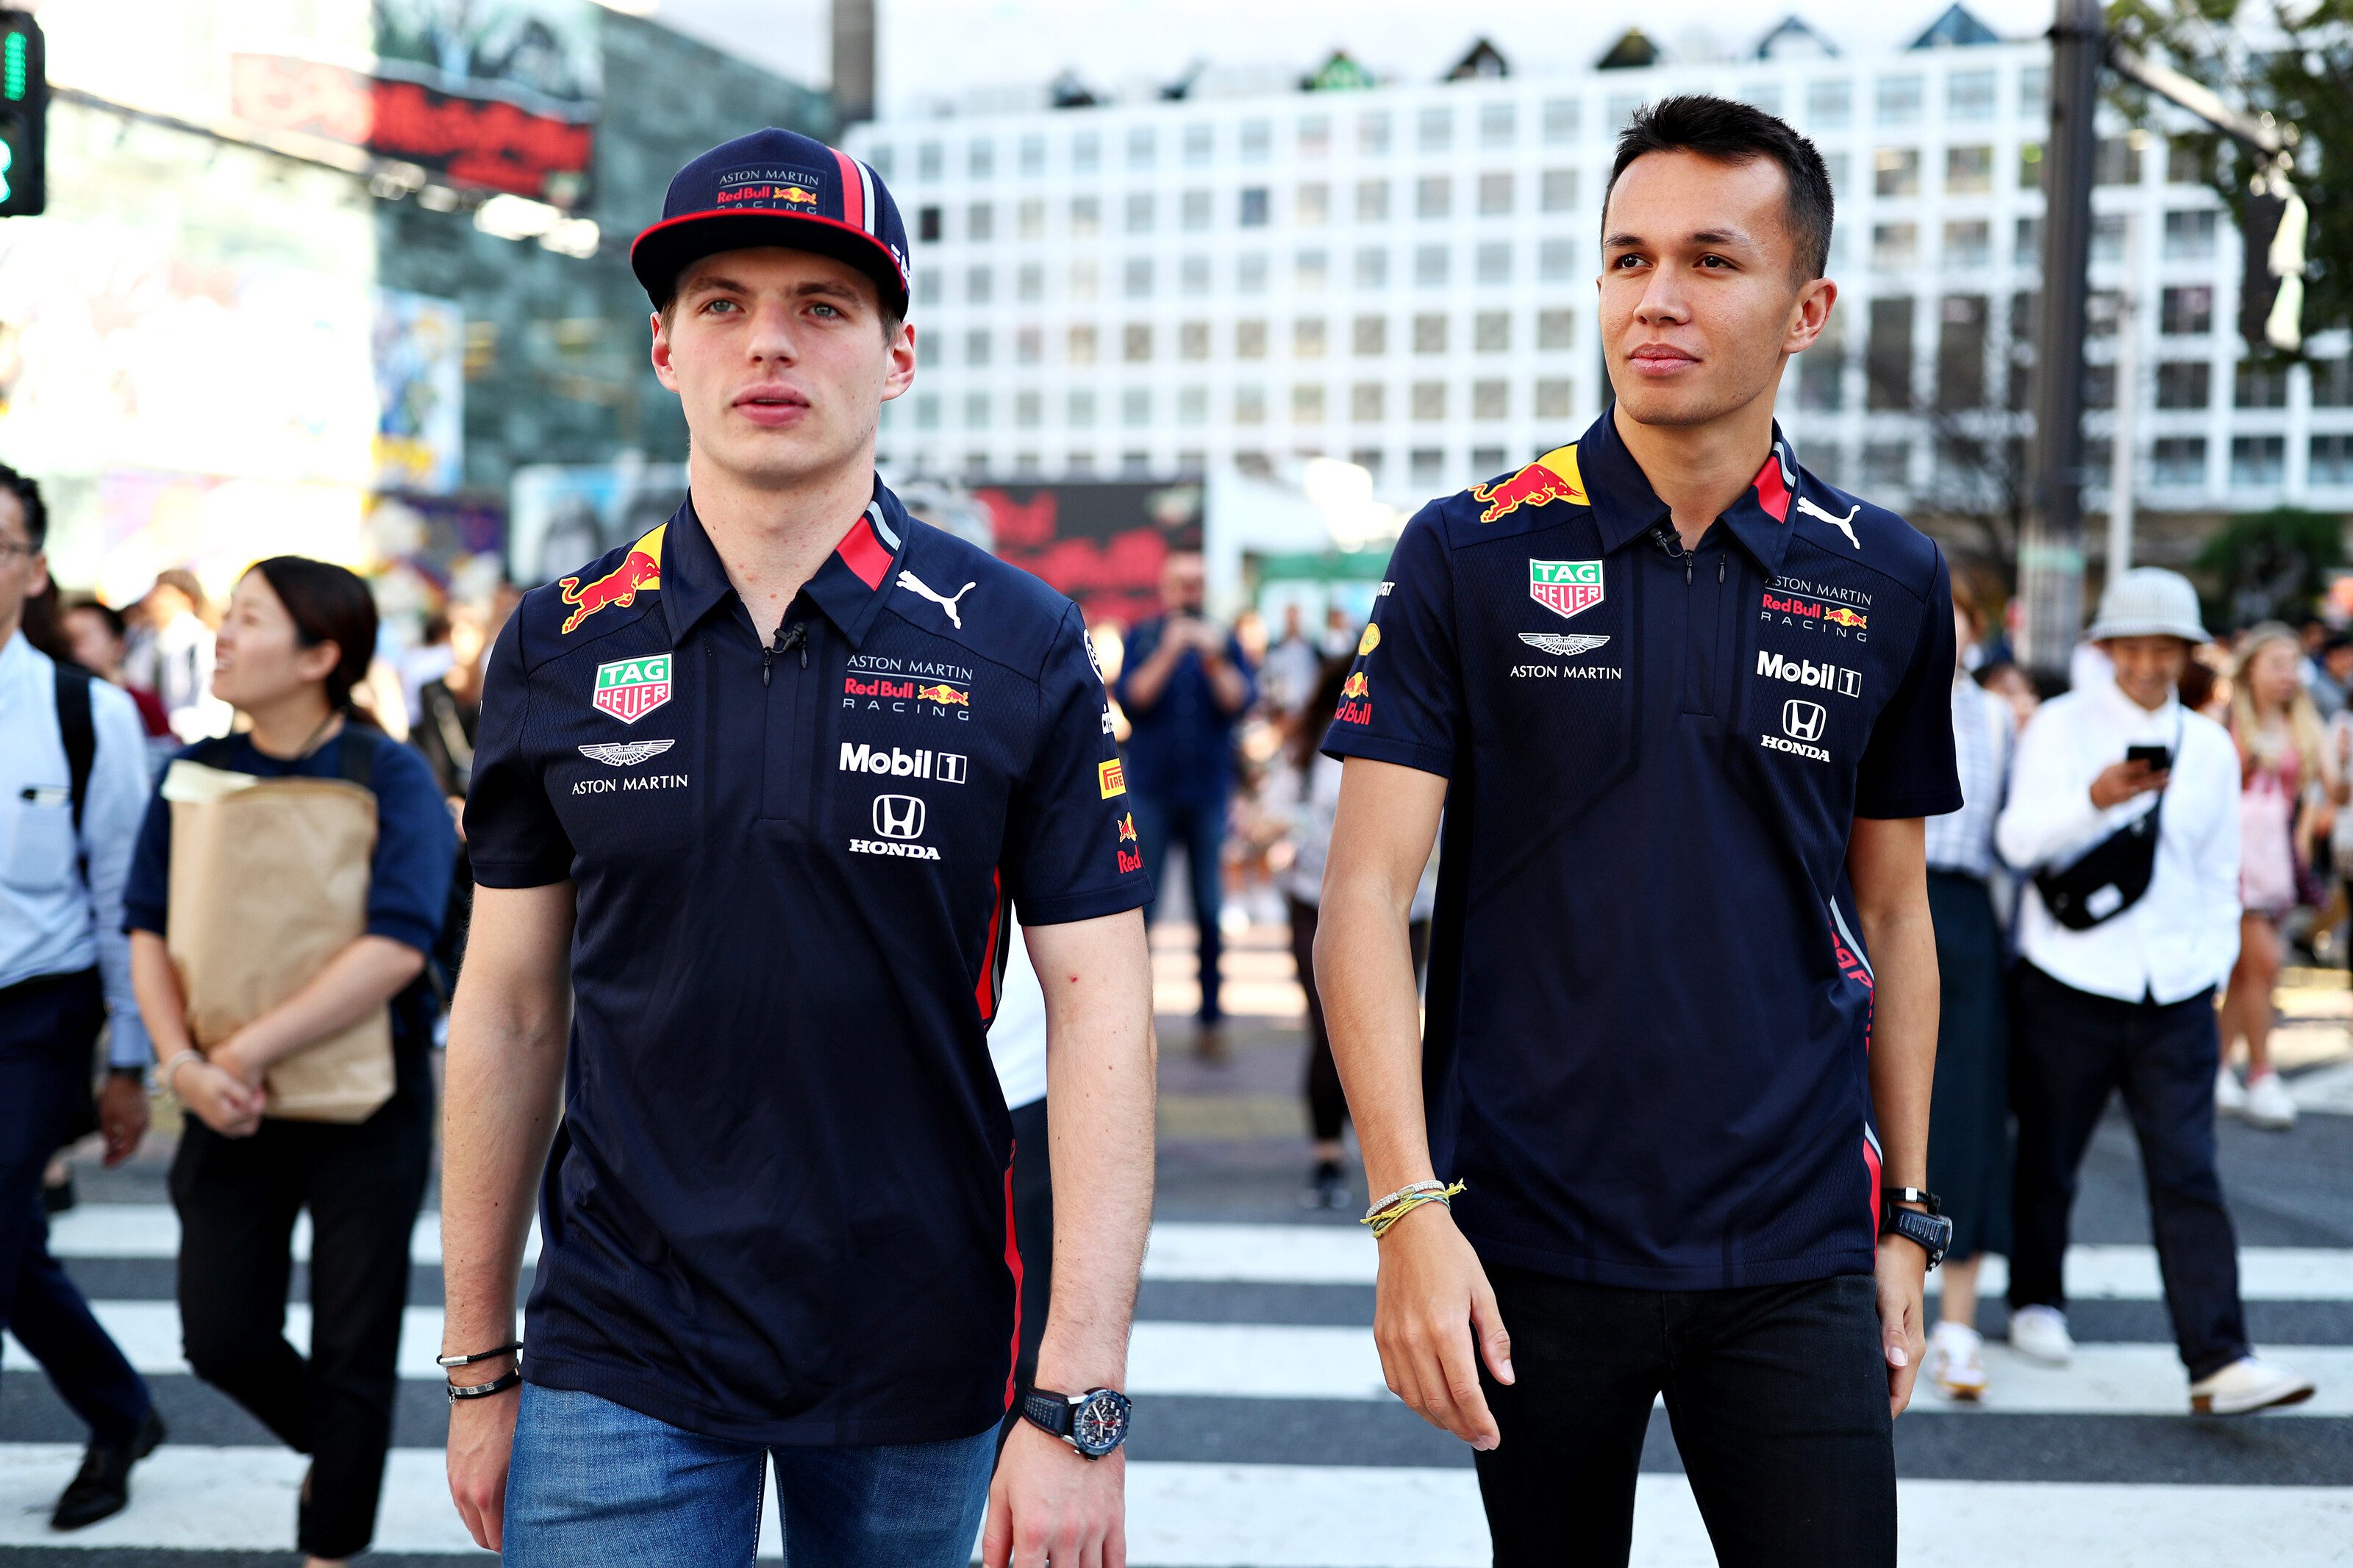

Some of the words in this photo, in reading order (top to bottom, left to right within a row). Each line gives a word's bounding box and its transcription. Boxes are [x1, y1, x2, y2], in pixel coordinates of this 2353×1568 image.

[719, 170, 760, 184] ASTON
[765, 169, 818, 185] MARTIN
[718, 187, 743, 204] Red
[743, 185, 771, 199] Bull
[1535, 564, 1596, 582] TAG
[1535, 584, 1599, 613] HEUER
[1762, 593, 1792, 612] Red
[1793, 600, 1821, 618] Bull
[1817, 584, 1872, 606] MARTIN
[1760, 611, 1867, 642] RACING
[604, 660, 665, 685] TAG
[847, 654, 901, 670] ASTON
[909, 660, 973, 681] MARTIN
[1510, 665, 1557, 678] ASTON
[1563, 666, 1622, 679] MARTIN
[1757, 650, 1835, 690] Mobil
[844, 678, 879, 696] Red
[880, 681, 914, 698] Bull
[599, 685, 666, 717] HEUER
[843, 698, 969, 721] RACING
[1343, 702, 1372, 726] Bull
[839, 742, 932, 779] Mobil
[1761, 734, 1830, 763] HONDA
[572, 778, 616, 795] ASTON
[623, 774, 688, 790] MARTIN
[849, 839, 941, 860] HONDA
[1117, 845, 1142, 874] Red
